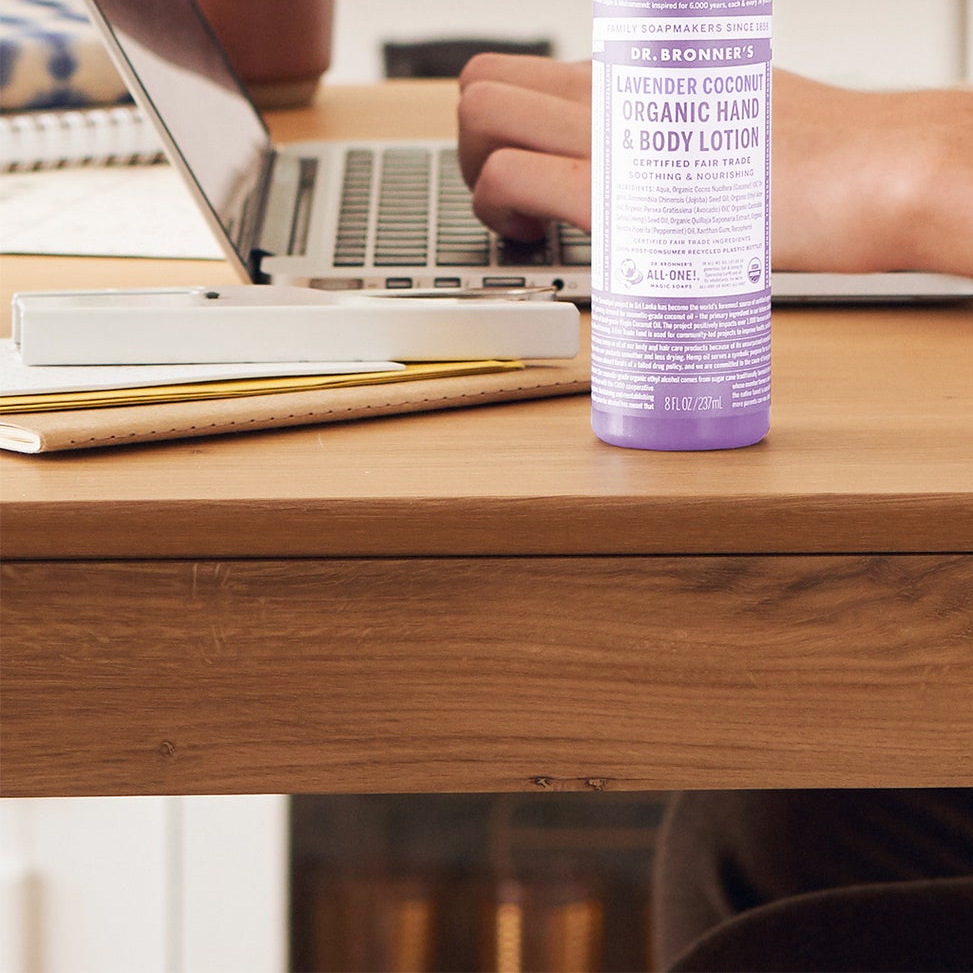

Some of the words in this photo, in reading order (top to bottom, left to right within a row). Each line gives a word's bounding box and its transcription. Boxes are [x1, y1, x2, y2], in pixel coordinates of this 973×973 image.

[606, 25, 638, 33] FAMILY
[641, 24, 722, 33] SOAPMAKERS
[726, 22, 754, 32] SINCE
[630, 46, 658, 61] DR.
[660, 45, 754, 62] BRONNER'S
[616, 76, 697, 95] LAVENDER
[702, 73, 764, 94] COCONUT
[622, 100, 710, 123] ORGANIC
[716, 98, 760, 122] HAND
[622, 128, 634, 150] &
[640, 130, 693, 152] BODY
[700, 126, 758, 152] LOTION
[632, 158, 690, 168] CERTIFIED
[694, 158, 718, 167] FAIR
[722, 156, 750, 166] TRADE
[629, 171, 682, 181] SOOTHING
[696, 169, 754, 180] NOURISHING
[712, 235, 751, 244] INGREDIENTS
[631, 247, 686, 255] POST-CONSUMER
[722, 245, 746, 254] PLASTIC
[646, 269, 696, 281] ALL-ONE!
[709, 312, 728, 321] primary
[673, 322, 692, 330] project
[684, 344, 709, 352] products
[686, 353, 702, 362] Hemp
[652, 362, 665, 371] drug
[660, 376, 680, 384] alcohol
[698, 376, 711, 384] from
[664, 396, 670, 410] 8
[672, 396, 680, 410] FL
